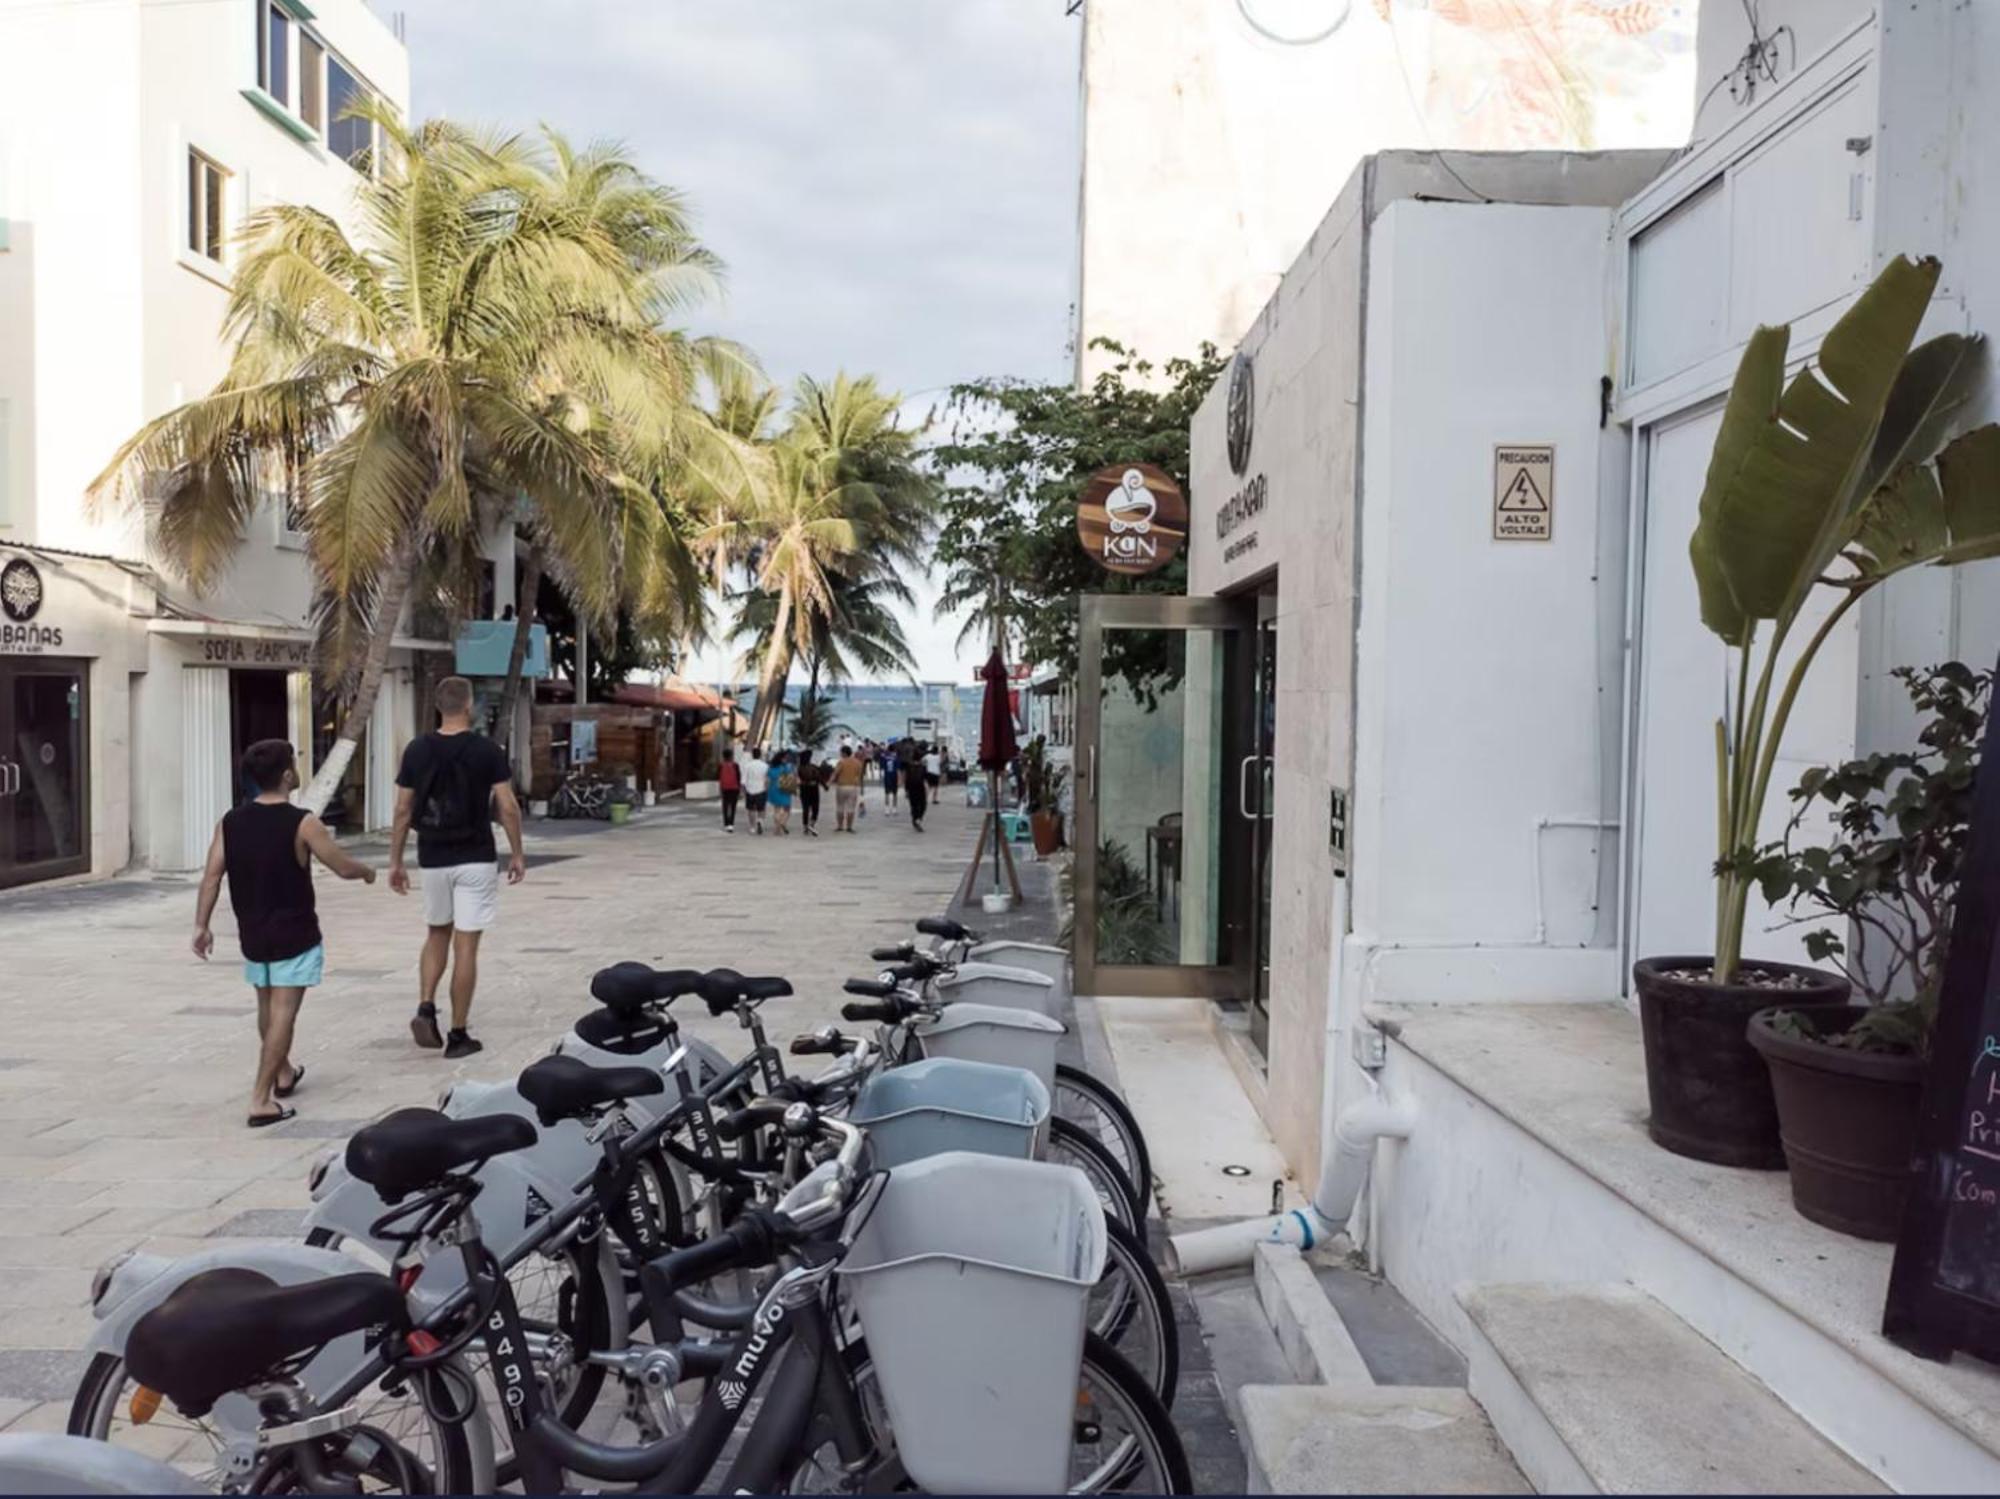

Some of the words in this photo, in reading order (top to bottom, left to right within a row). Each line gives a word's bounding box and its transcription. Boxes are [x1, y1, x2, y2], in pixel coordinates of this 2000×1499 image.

[1504, 514, 1540, 524] ALTO
[1500, 525, 1546, 534] VOLTAJE
[0, 622, 63, 646] BAÑAS
[735, 1305, 784, 1378] muvo
